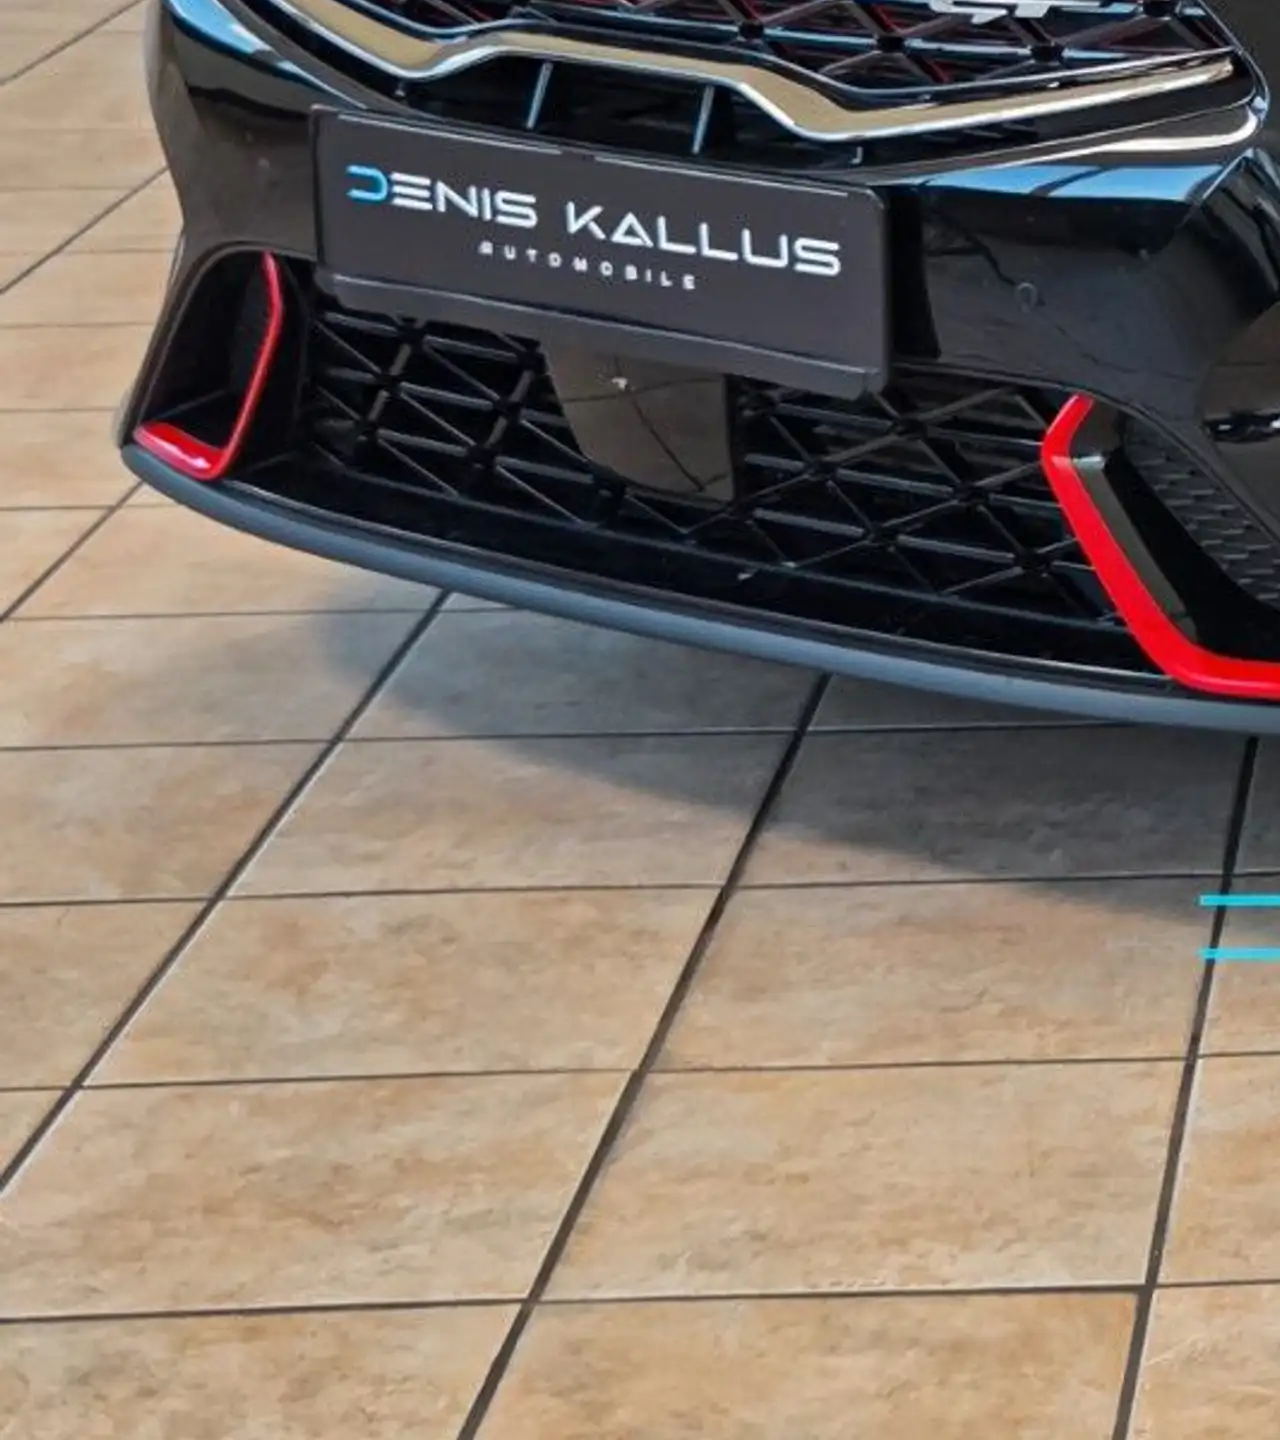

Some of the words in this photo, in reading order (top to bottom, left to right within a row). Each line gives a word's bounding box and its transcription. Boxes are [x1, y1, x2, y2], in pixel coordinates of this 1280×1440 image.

[346, 164, 539, 229] DENIS
[566, 201, 842, 277] KALLUS
[478, 240, 697, 291] AUTOMOBILE
